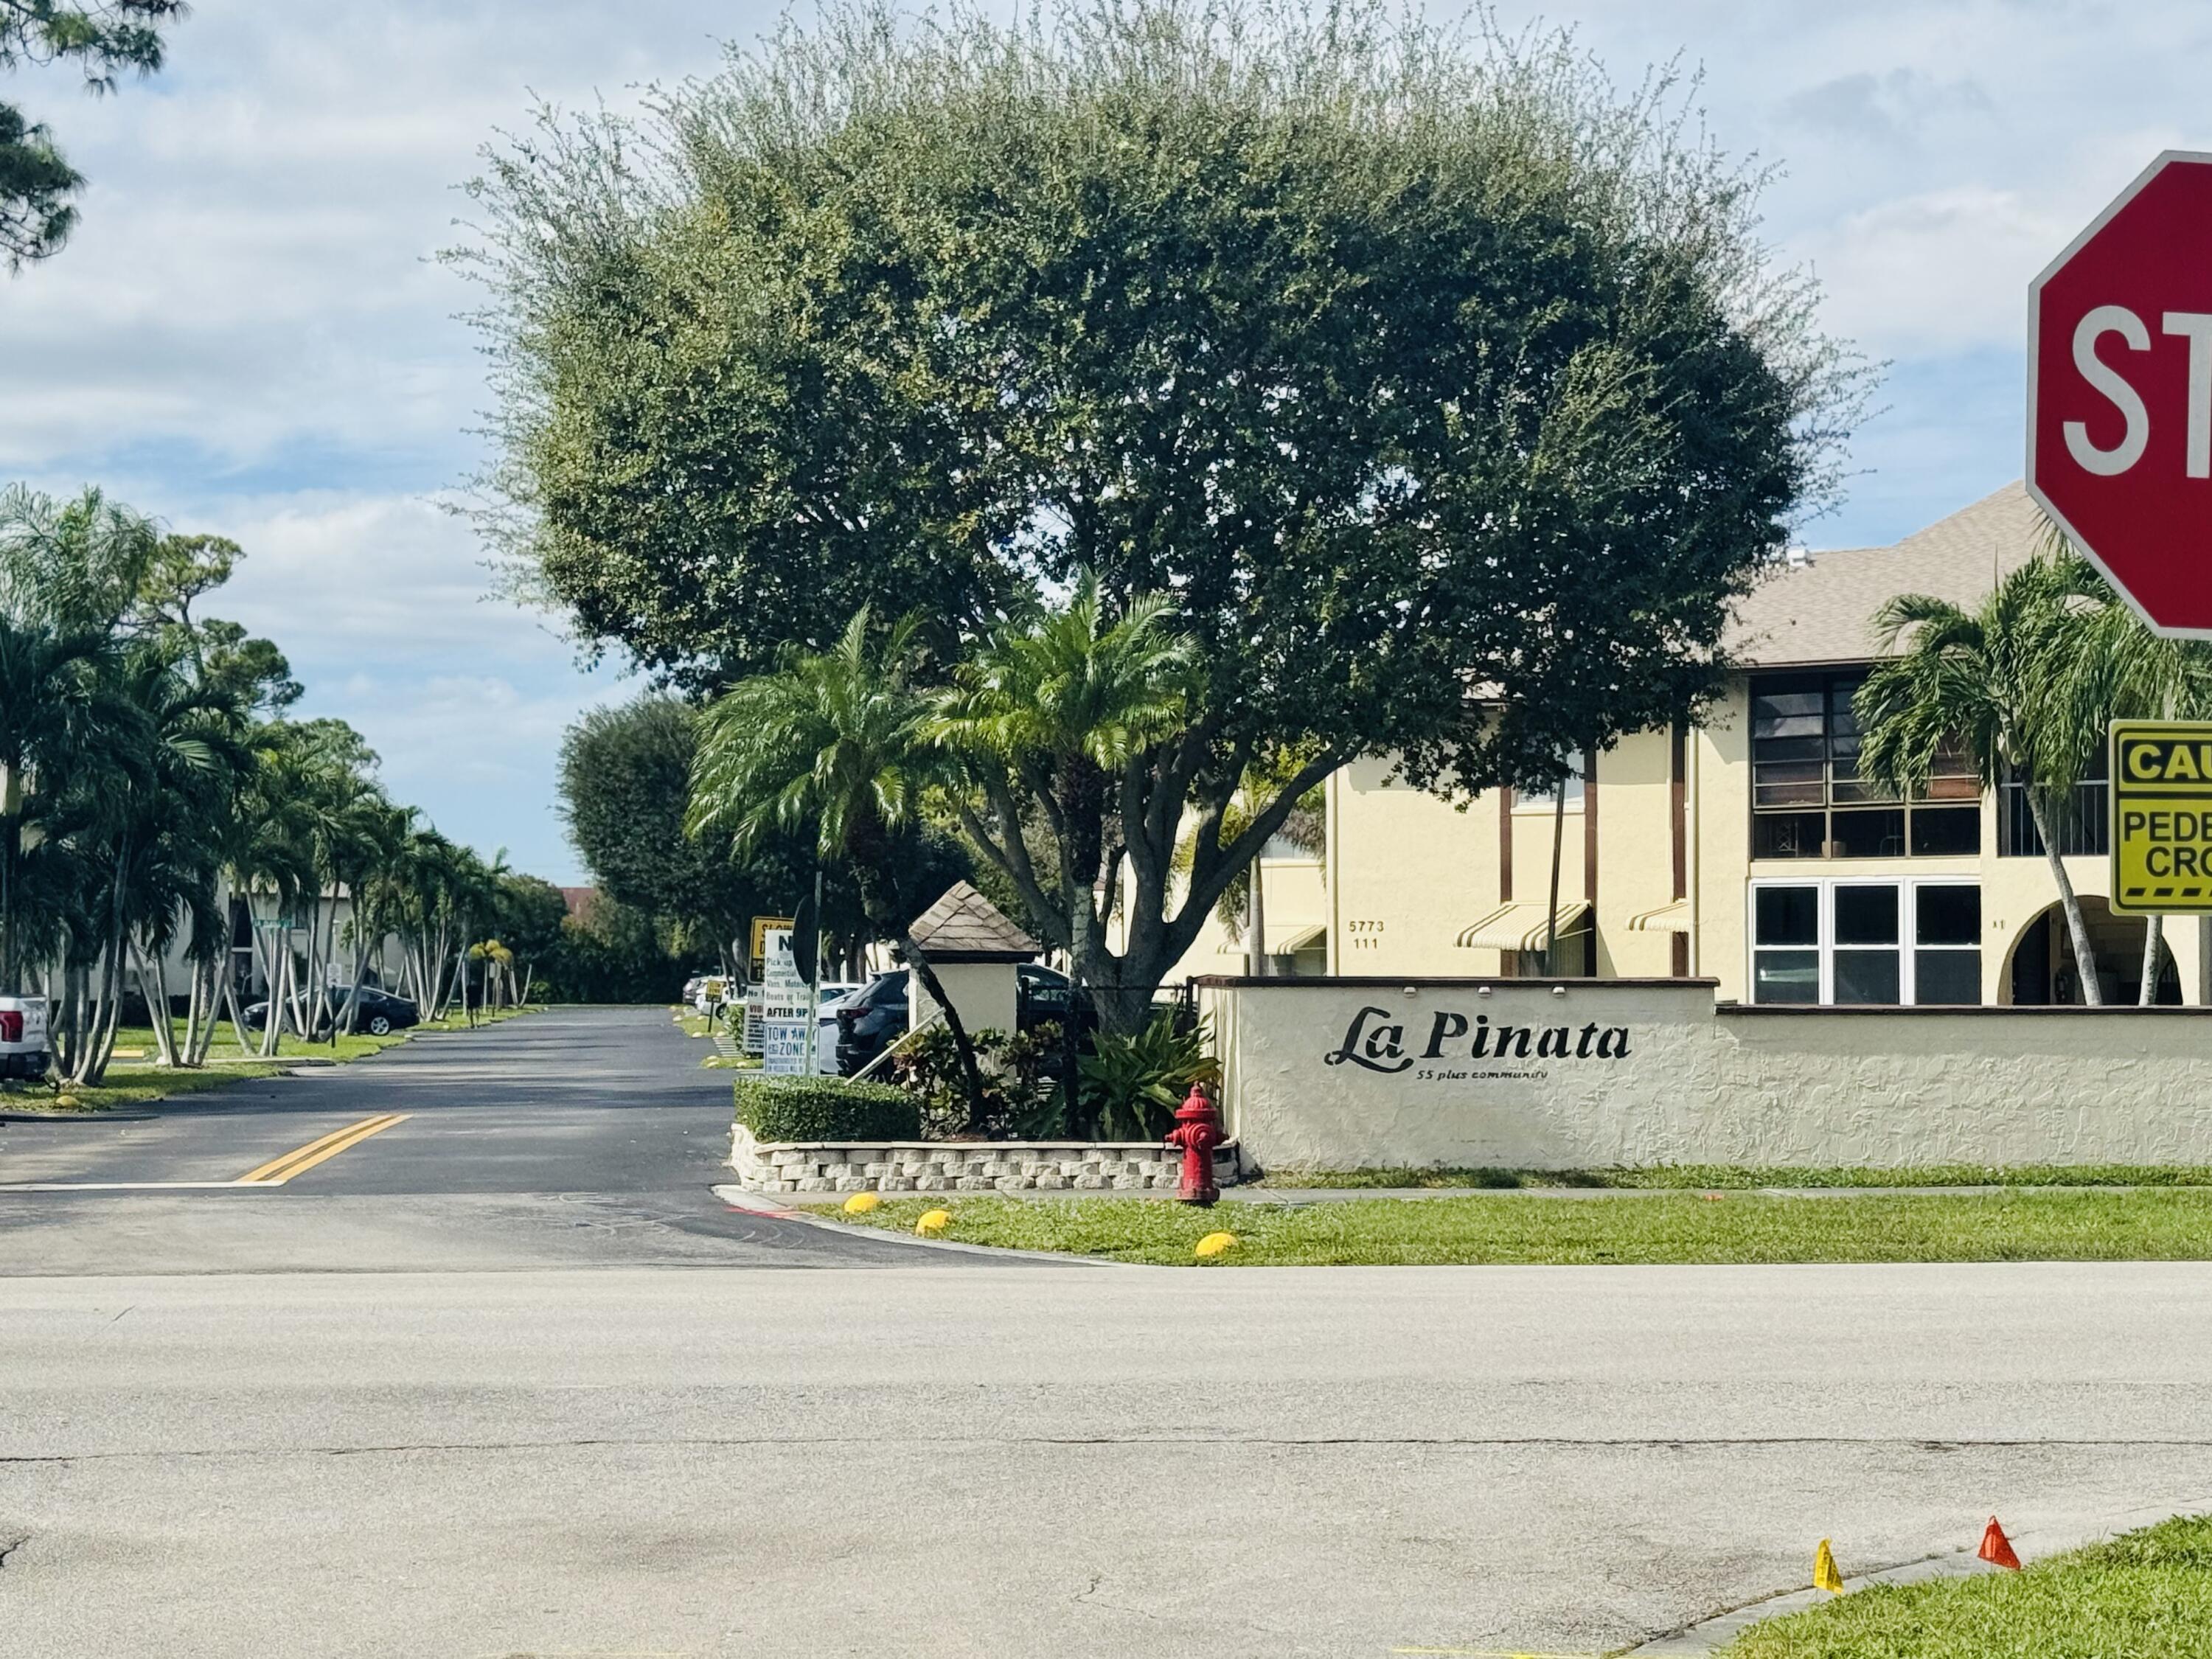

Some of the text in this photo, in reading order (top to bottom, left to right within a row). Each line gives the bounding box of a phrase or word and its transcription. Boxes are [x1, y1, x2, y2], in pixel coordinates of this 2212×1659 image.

[2063, 305, 2212, 479] ST
[1349, 920, 1385, 932] 5773
[779, 935, 793, 951] N
[1354, 937, 1377, 950] 111
[767, 957, 781, 966] Pick
[767, 1007, 793, 1018] AFTER
[768, 1027, 787, 1040] TOW
[791, 1027, 817, 1040] AWY
[1324, 1006, 1632, 1073] La Pinata
[779, 1042, 805, 1056] ZONE
[1416, 1070, 1434, 1079] 55
[1437, 1069, 1468, 1080] plus
